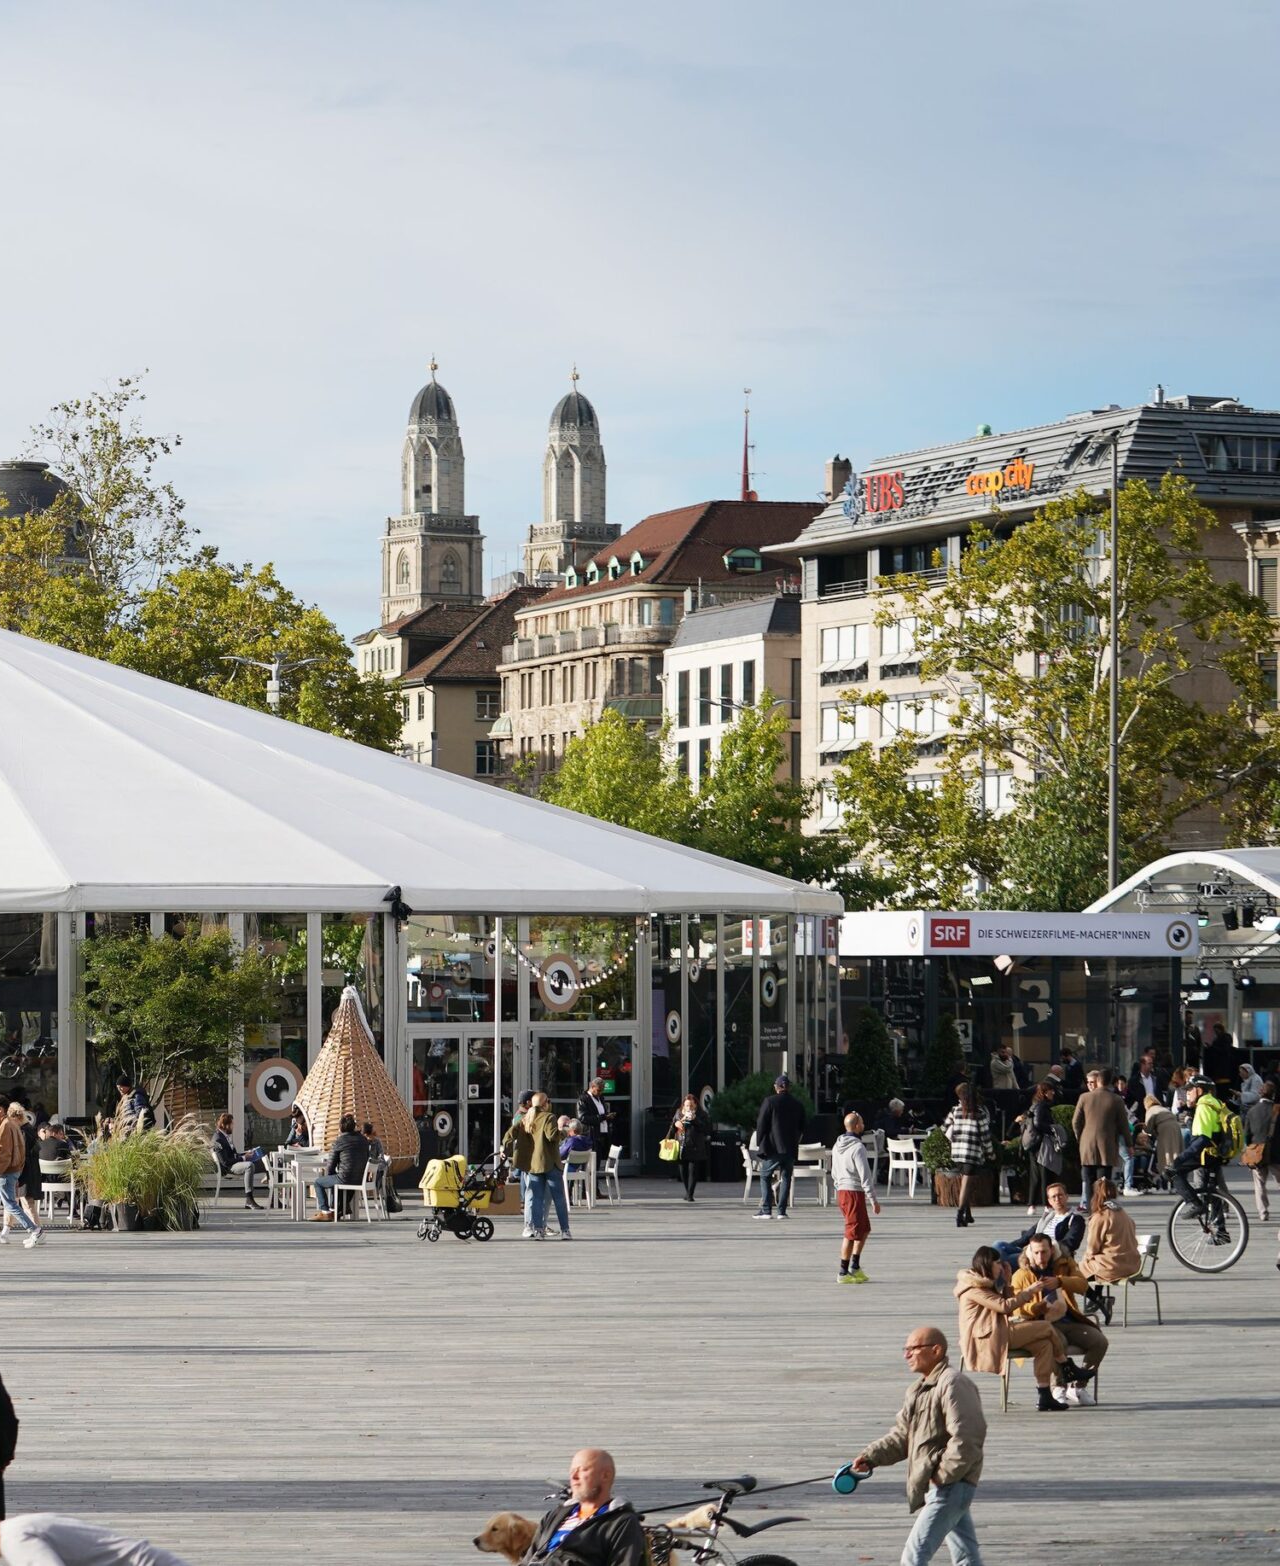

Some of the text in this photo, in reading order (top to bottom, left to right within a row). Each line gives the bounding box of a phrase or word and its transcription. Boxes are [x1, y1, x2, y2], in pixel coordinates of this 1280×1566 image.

[865, 470, 905, 513] UBS
[965, 458, 1036, 497] coop city
[934, 925, 967, 942] SRF
[978, 929, 993, 939] DIE
